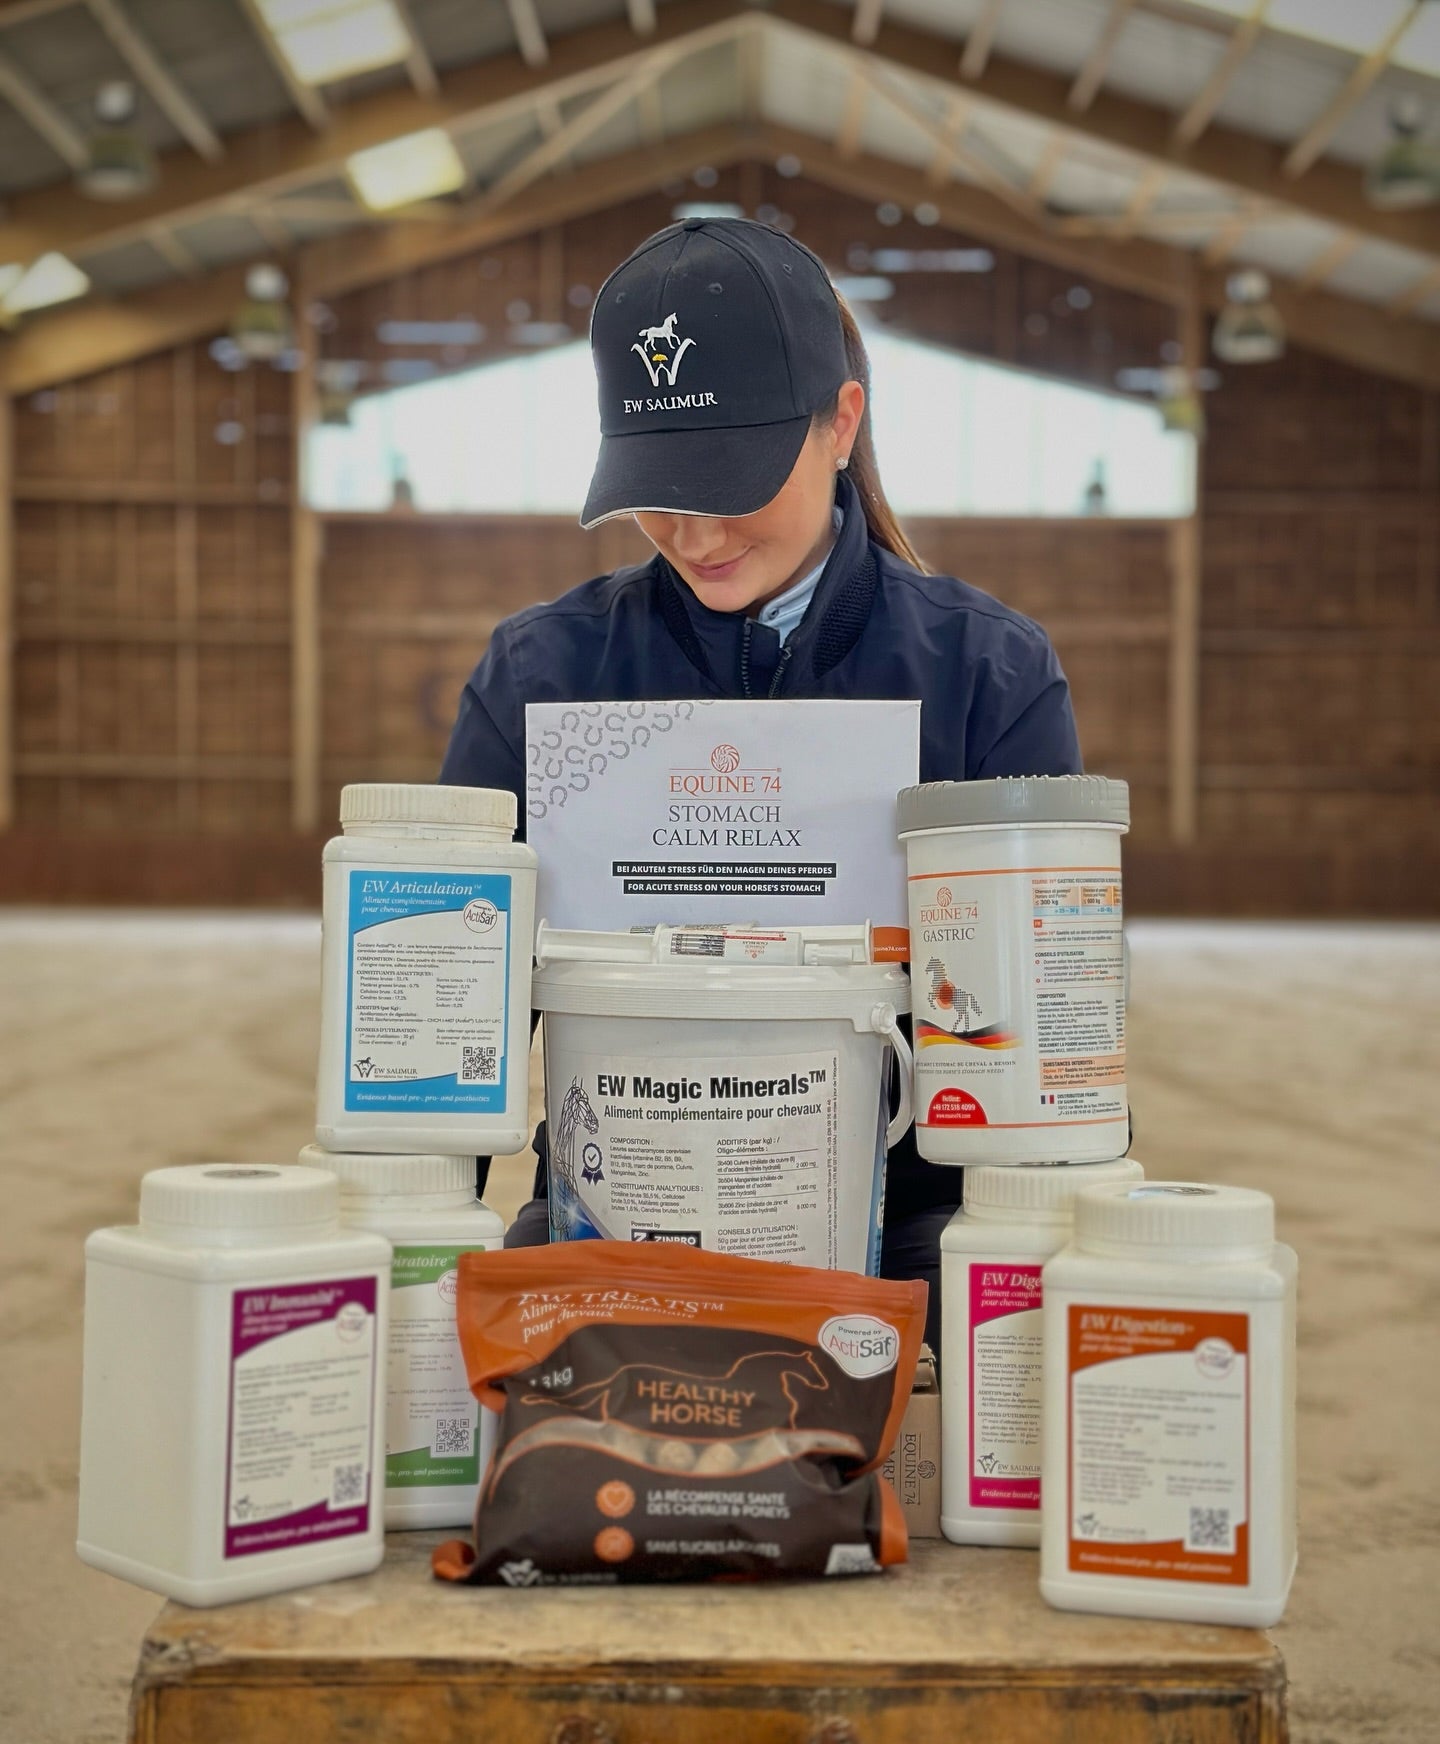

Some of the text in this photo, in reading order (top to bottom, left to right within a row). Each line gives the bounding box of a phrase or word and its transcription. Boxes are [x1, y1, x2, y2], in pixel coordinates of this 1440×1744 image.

[624, 392, 718, 413] EW SAUMUR
[670, 775, 782, 797] EQUINE 74
[668, 804, 781, 823] STOMACH
[652, 828, 802, 847] CALM RELAX
[616, 865, 629, 873] BEI
[631, 865, 665, 873] AKUTEM
[698, 864, 714, 874] FÜR
[715, 866, 733, 874] DEN
[734, 866, 766, 874] MAGEN
[767, 866, 796, 874] DEINES
[798, 866, 832, 875] PFERDES
[362, 879, 389, 893] EW
[627, 883, 821, 892] FOR ACUTE STRESS ON YOUR HORSE'S STOMACH
[920, 906, 978, 924] EQUINE 74
[923, 927, 975, 943] GASTRIC
[597, 1074, 626, 1097] EW
[632, 1076, 702, 1104] Magic
[604, 1103, 822, 1123] Aliment complémentaire pour chevaux
[609, 1137, 651, 1145] COMPOSITION
[716, 1138, 748, 1146] ADDITIFS
[748, 1138, 762, 1146] (par
[610, 1182, 700, 1192] CONSTITUANTS ANALYTIQUES
[717, 1224, 796, 1236] CONSEILS D'UTILISATION
[739, 1236, 749, 1244] jour
[981, 1272, 1041, 1290] EW Dige
[524, 1308, 615, 1344] pour chevaux
[838, 1326, 872, 1336] Powered
[637, 1380, 756, 1407] HEALTHY
[651, 1402, 742, 1428] HORSE
[903, 1433, 917, 1506] EQUINE 74
[647, 1489, 663, 1502] LA
[664, 1488, 745, 1504] RÉCOMPENSE
[646, 1502, 671, 1516] DES
